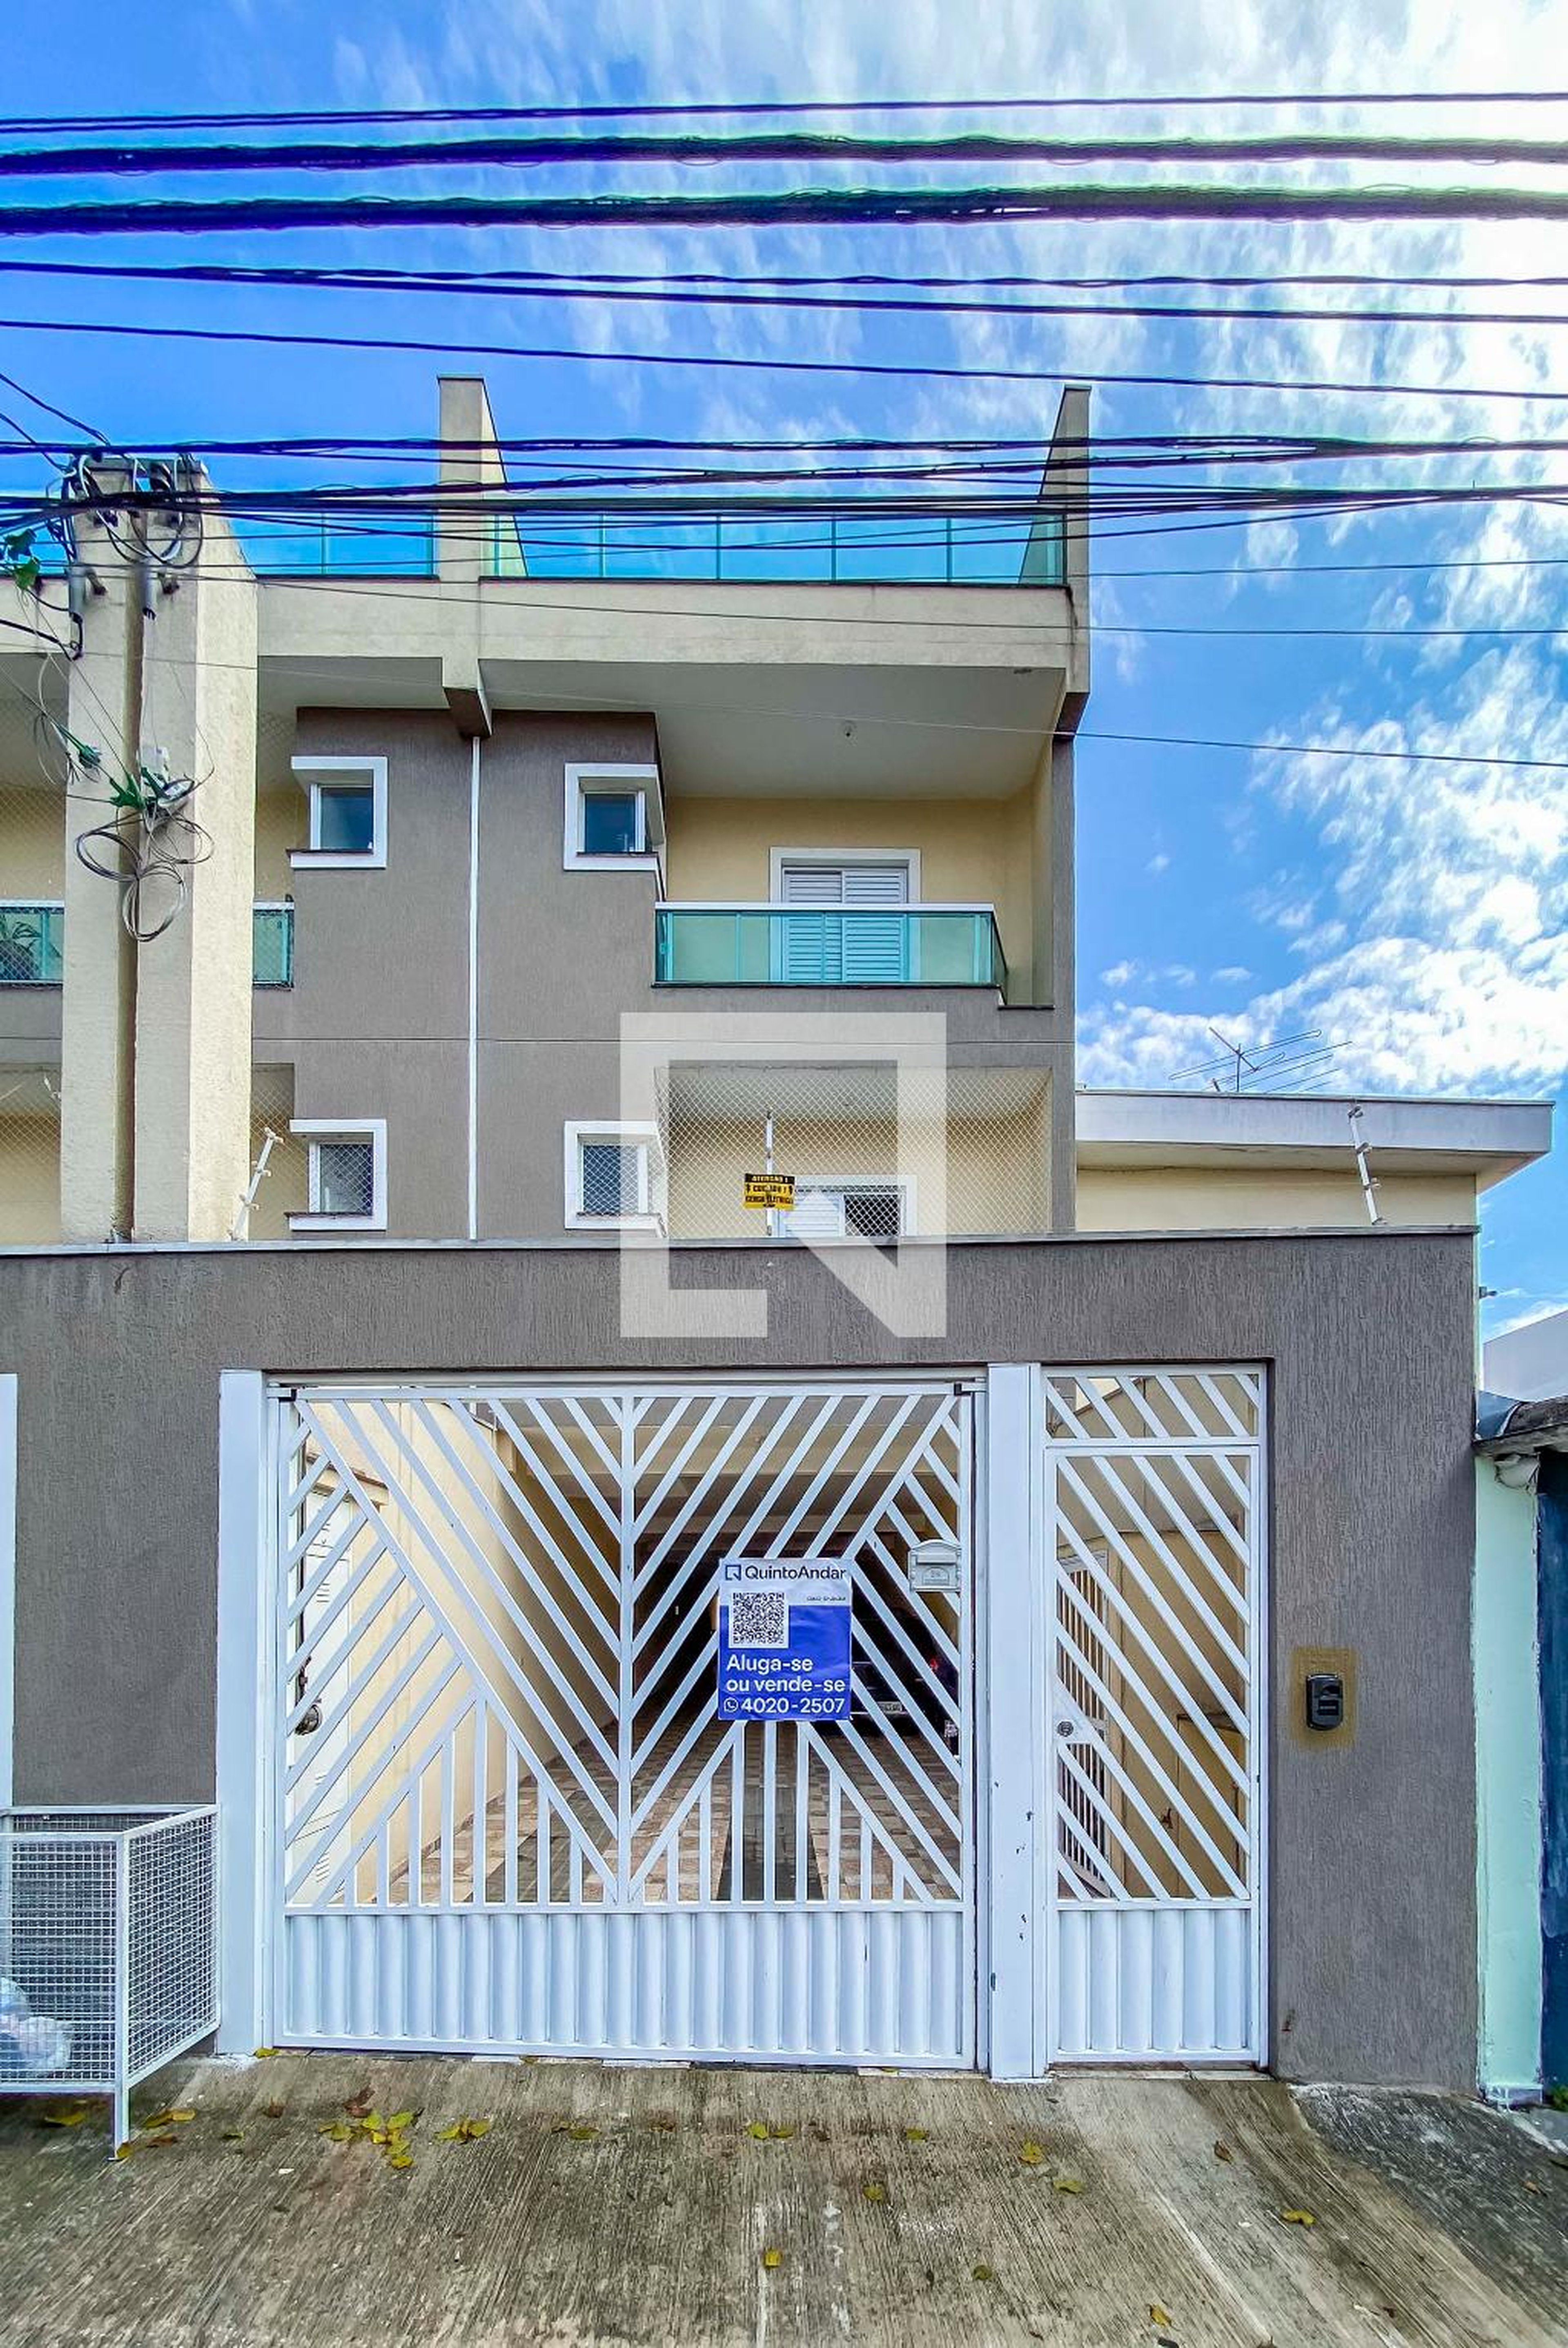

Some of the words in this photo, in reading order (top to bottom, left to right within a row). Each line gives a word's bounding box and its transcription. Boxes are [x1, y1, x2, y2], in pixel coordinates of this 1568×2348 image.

[745, 1565, 846, 1581] QuintoAndar
[726, 1655, 813, 1675] Aluga-se
[726, 1680, 749, 1692] ou
[754, 1676, 846, 1692] vende-se
[741, 1698, 844, 1713] 4020-2507
